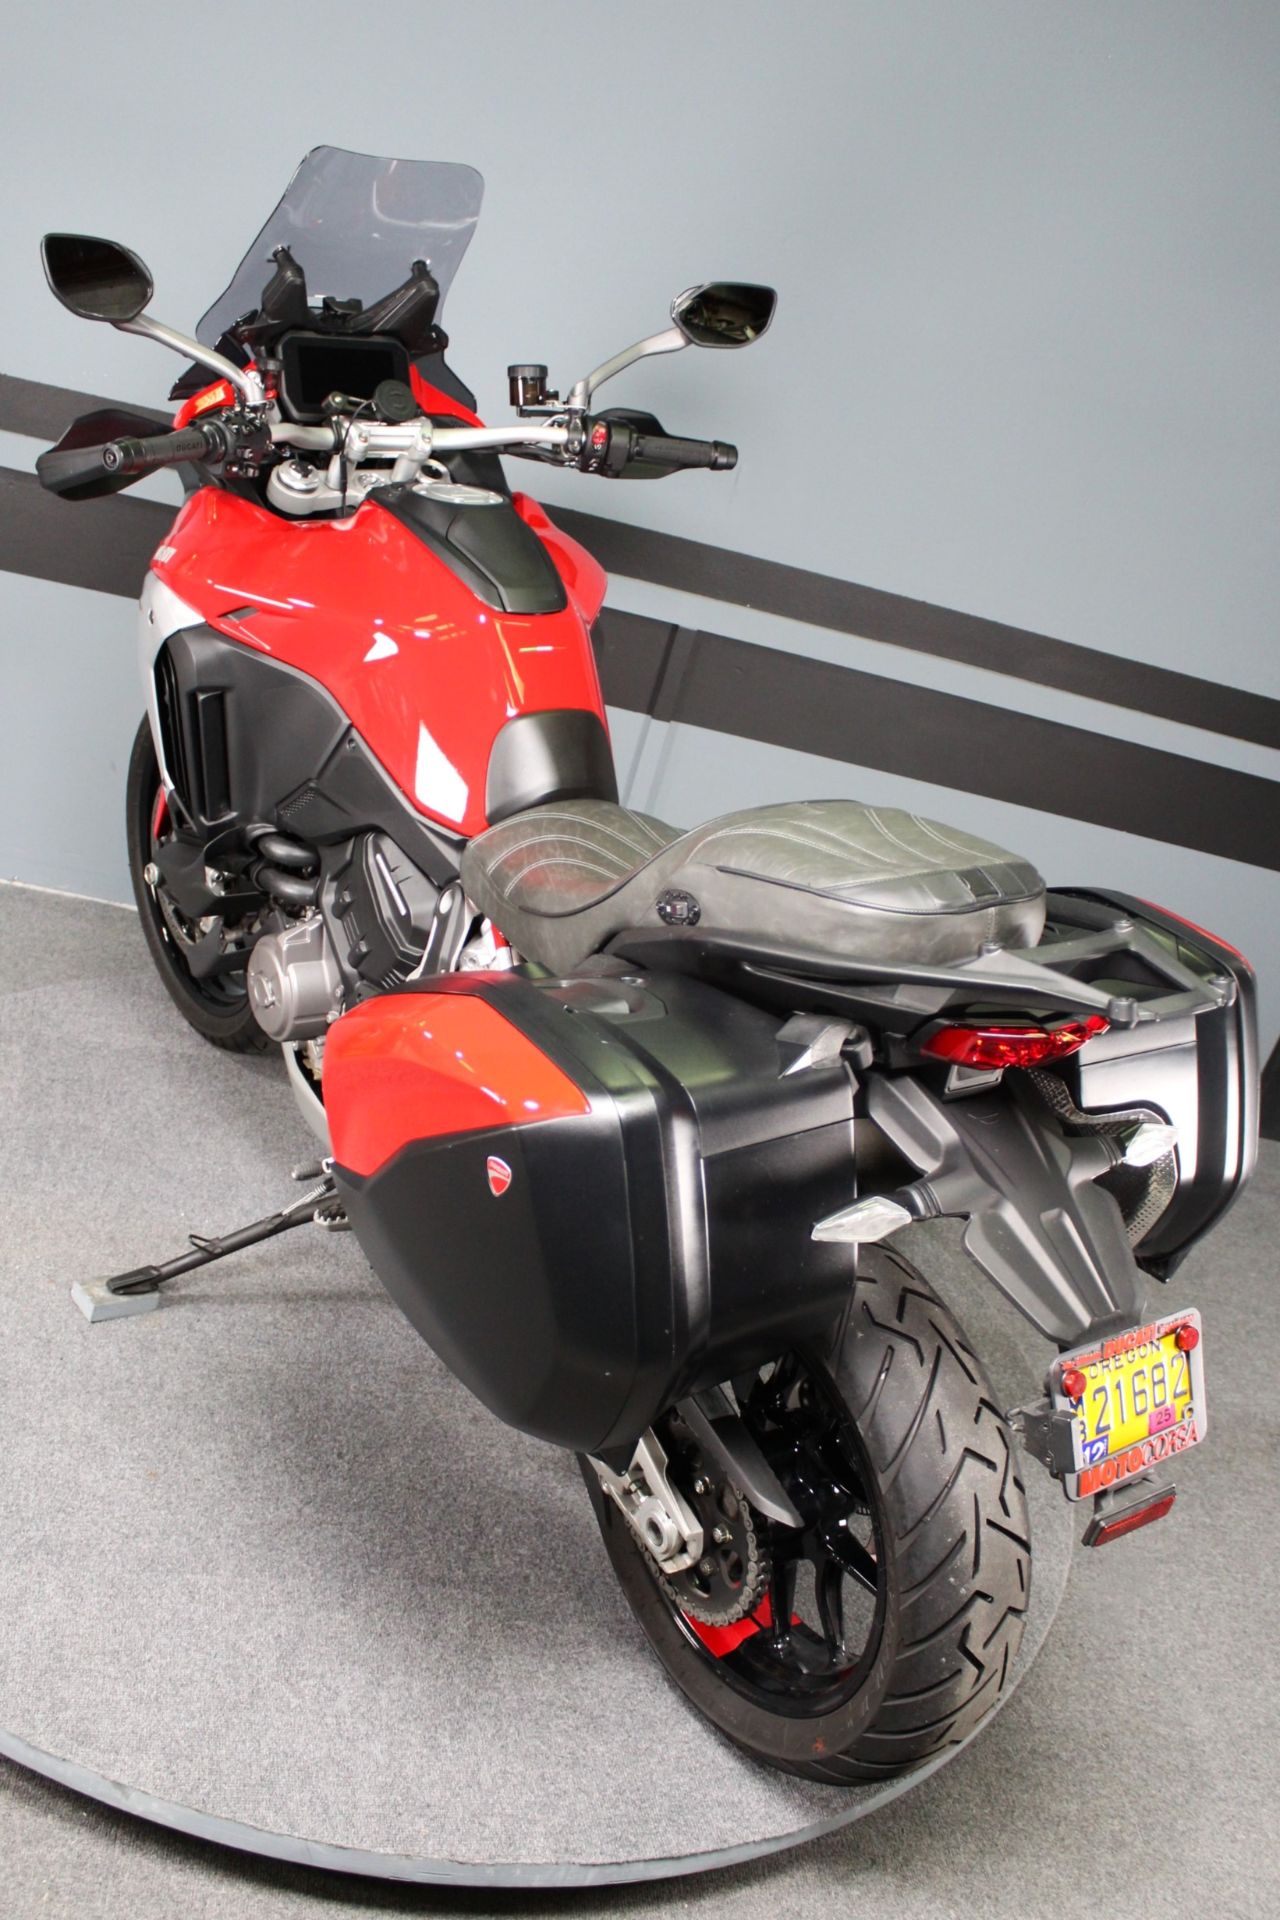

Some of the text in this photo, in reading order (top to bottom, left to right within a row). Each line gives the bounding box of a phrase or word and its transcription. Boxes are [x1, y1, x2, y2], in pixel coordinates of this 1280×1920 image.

[1089, 1340, 1162, 1379] OREGON
[1093, 1353, 1189, 1435] 21682
[1156, 1408, 1172, 1427] 25
[1078, 1421, 1199, 1498] MOTOCORSA
